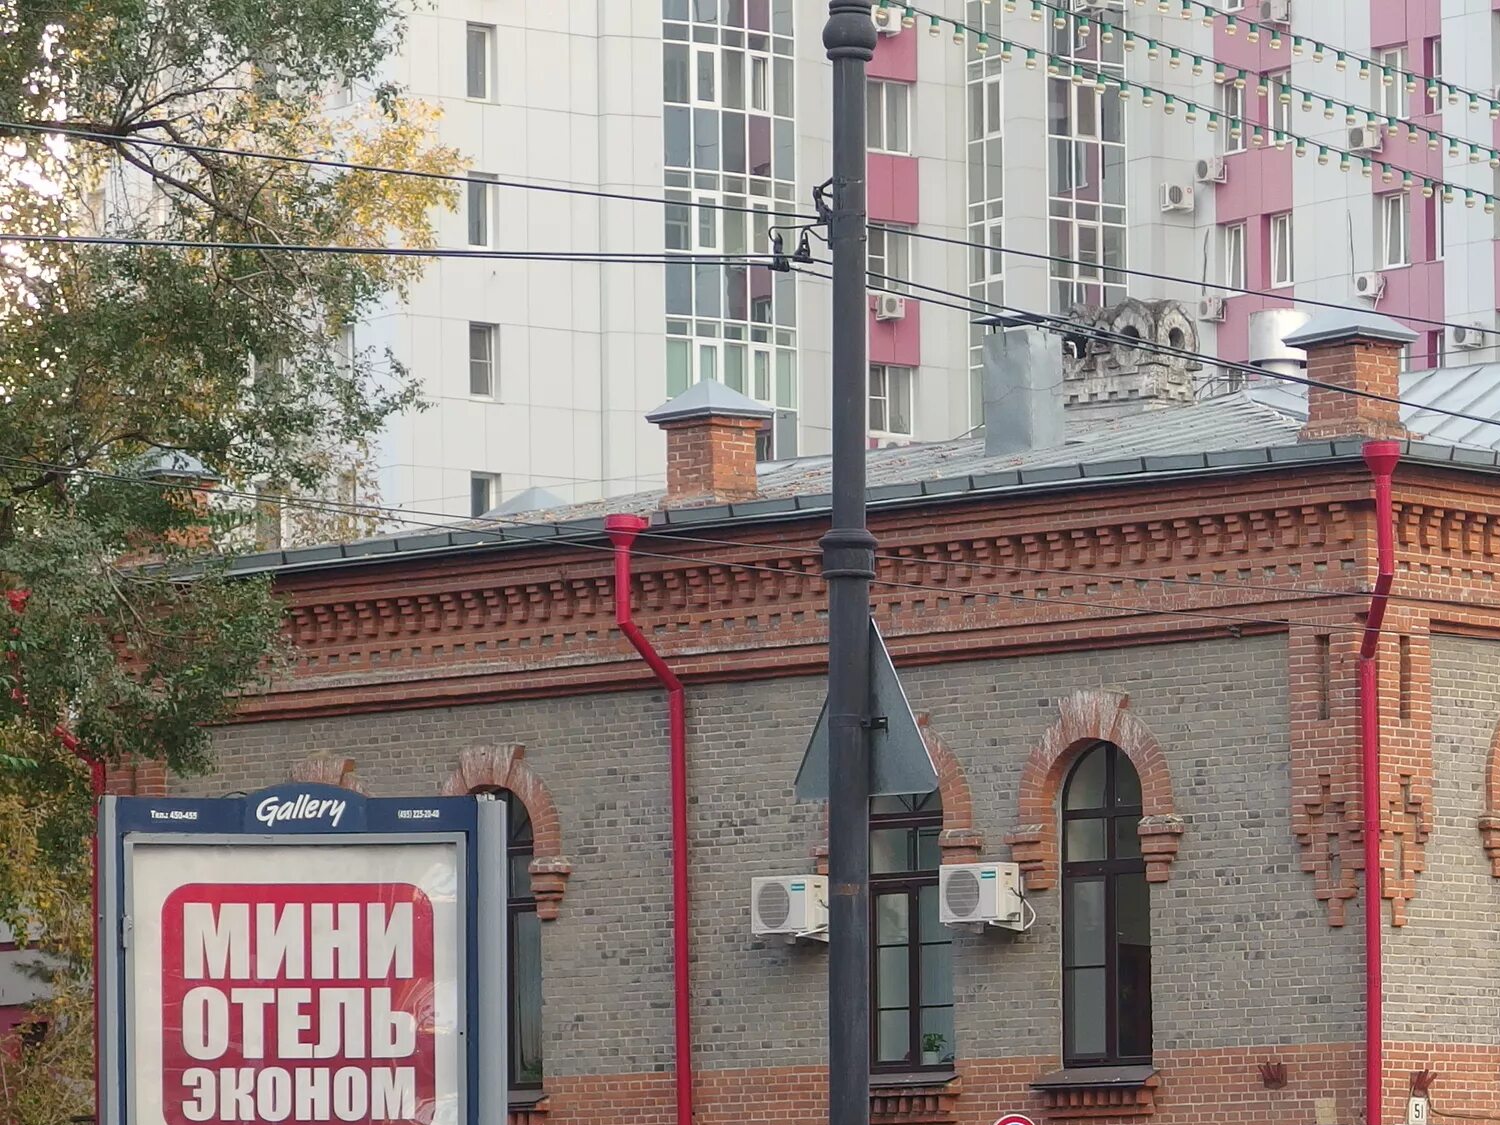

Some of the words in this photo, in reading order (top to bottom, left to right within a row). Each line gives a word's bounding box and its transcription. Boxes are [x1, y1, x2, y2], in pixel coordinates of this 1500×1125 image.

[256, 794, 346, 827] Gallery
[183, 902, 414, 980] МИНИ
[182, 986, 417, 1060] ОТЕЛЬ
[182, 1066, 416, 1122] ЭКОНОМ
